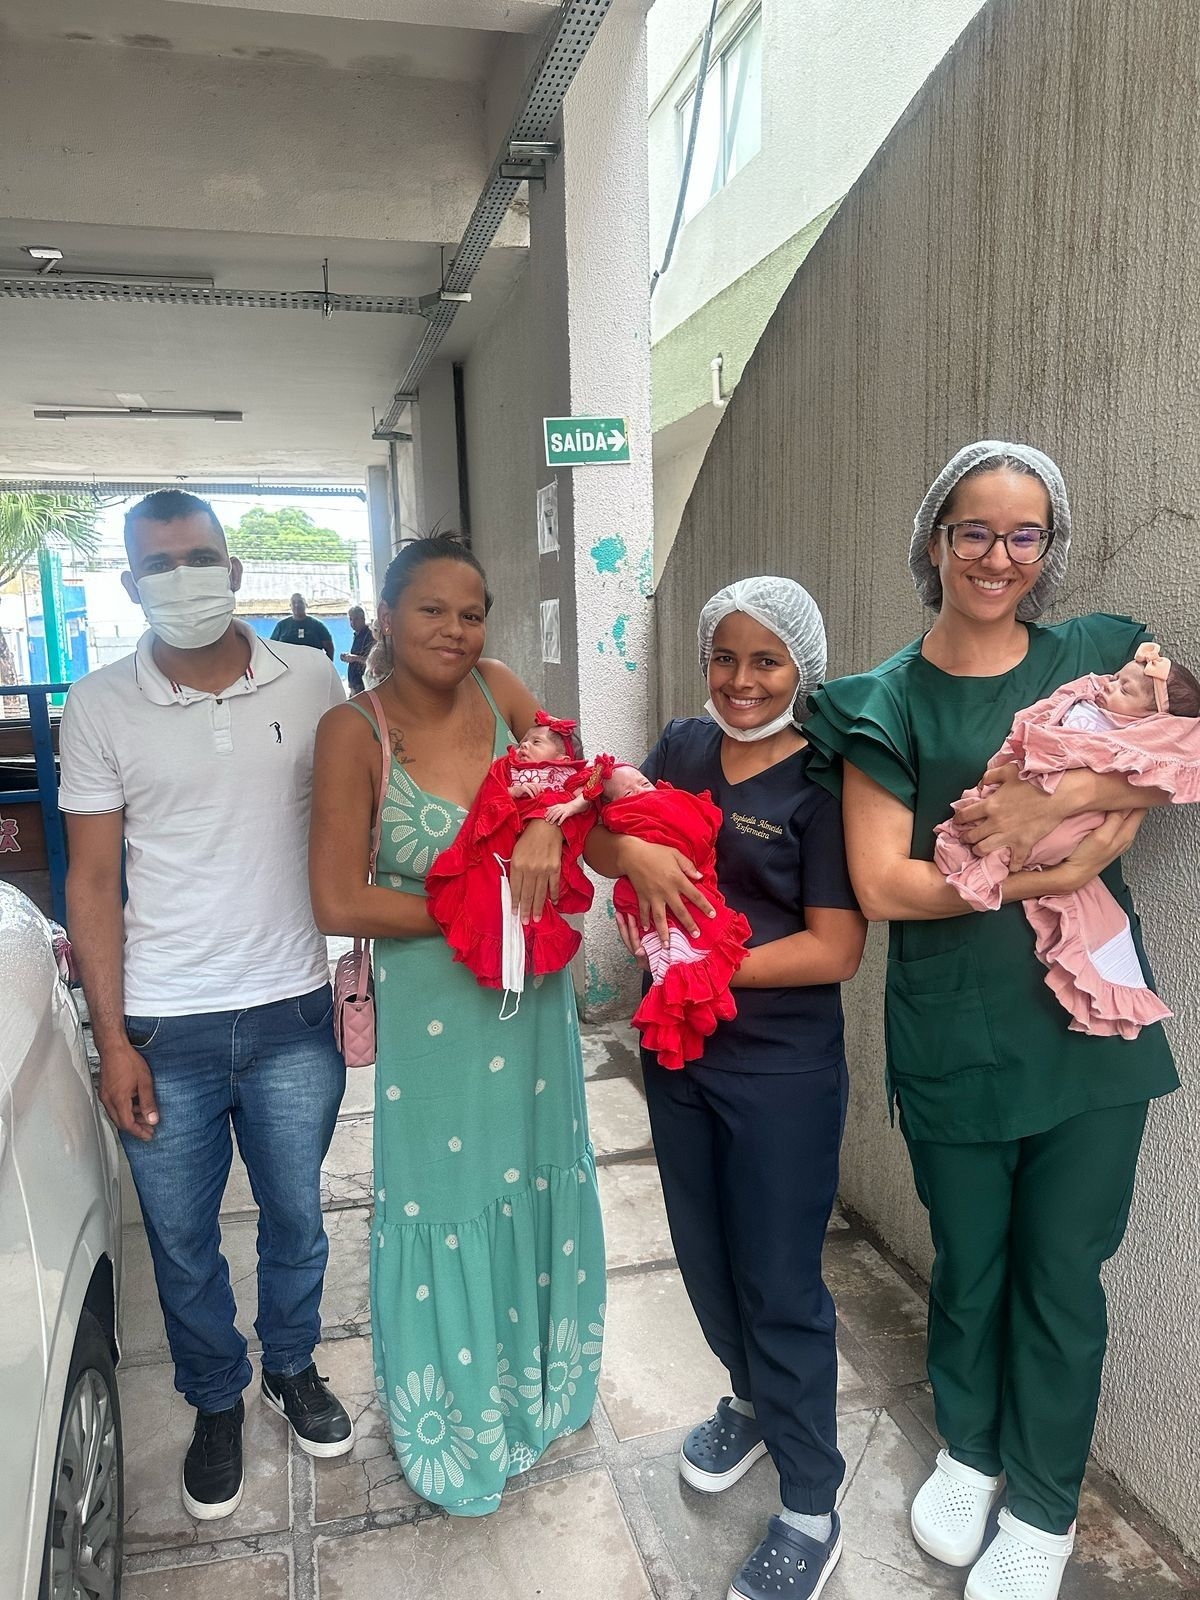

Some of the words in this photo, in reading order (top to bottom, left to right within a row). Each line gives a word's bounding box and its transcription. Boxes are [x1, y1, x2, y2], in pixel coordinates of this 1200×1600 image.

[551, 428, 608, 452] SAÍDA
[736, 823, 769, 839] Enfermeira
[757, 819, 783, 834] Almeida
